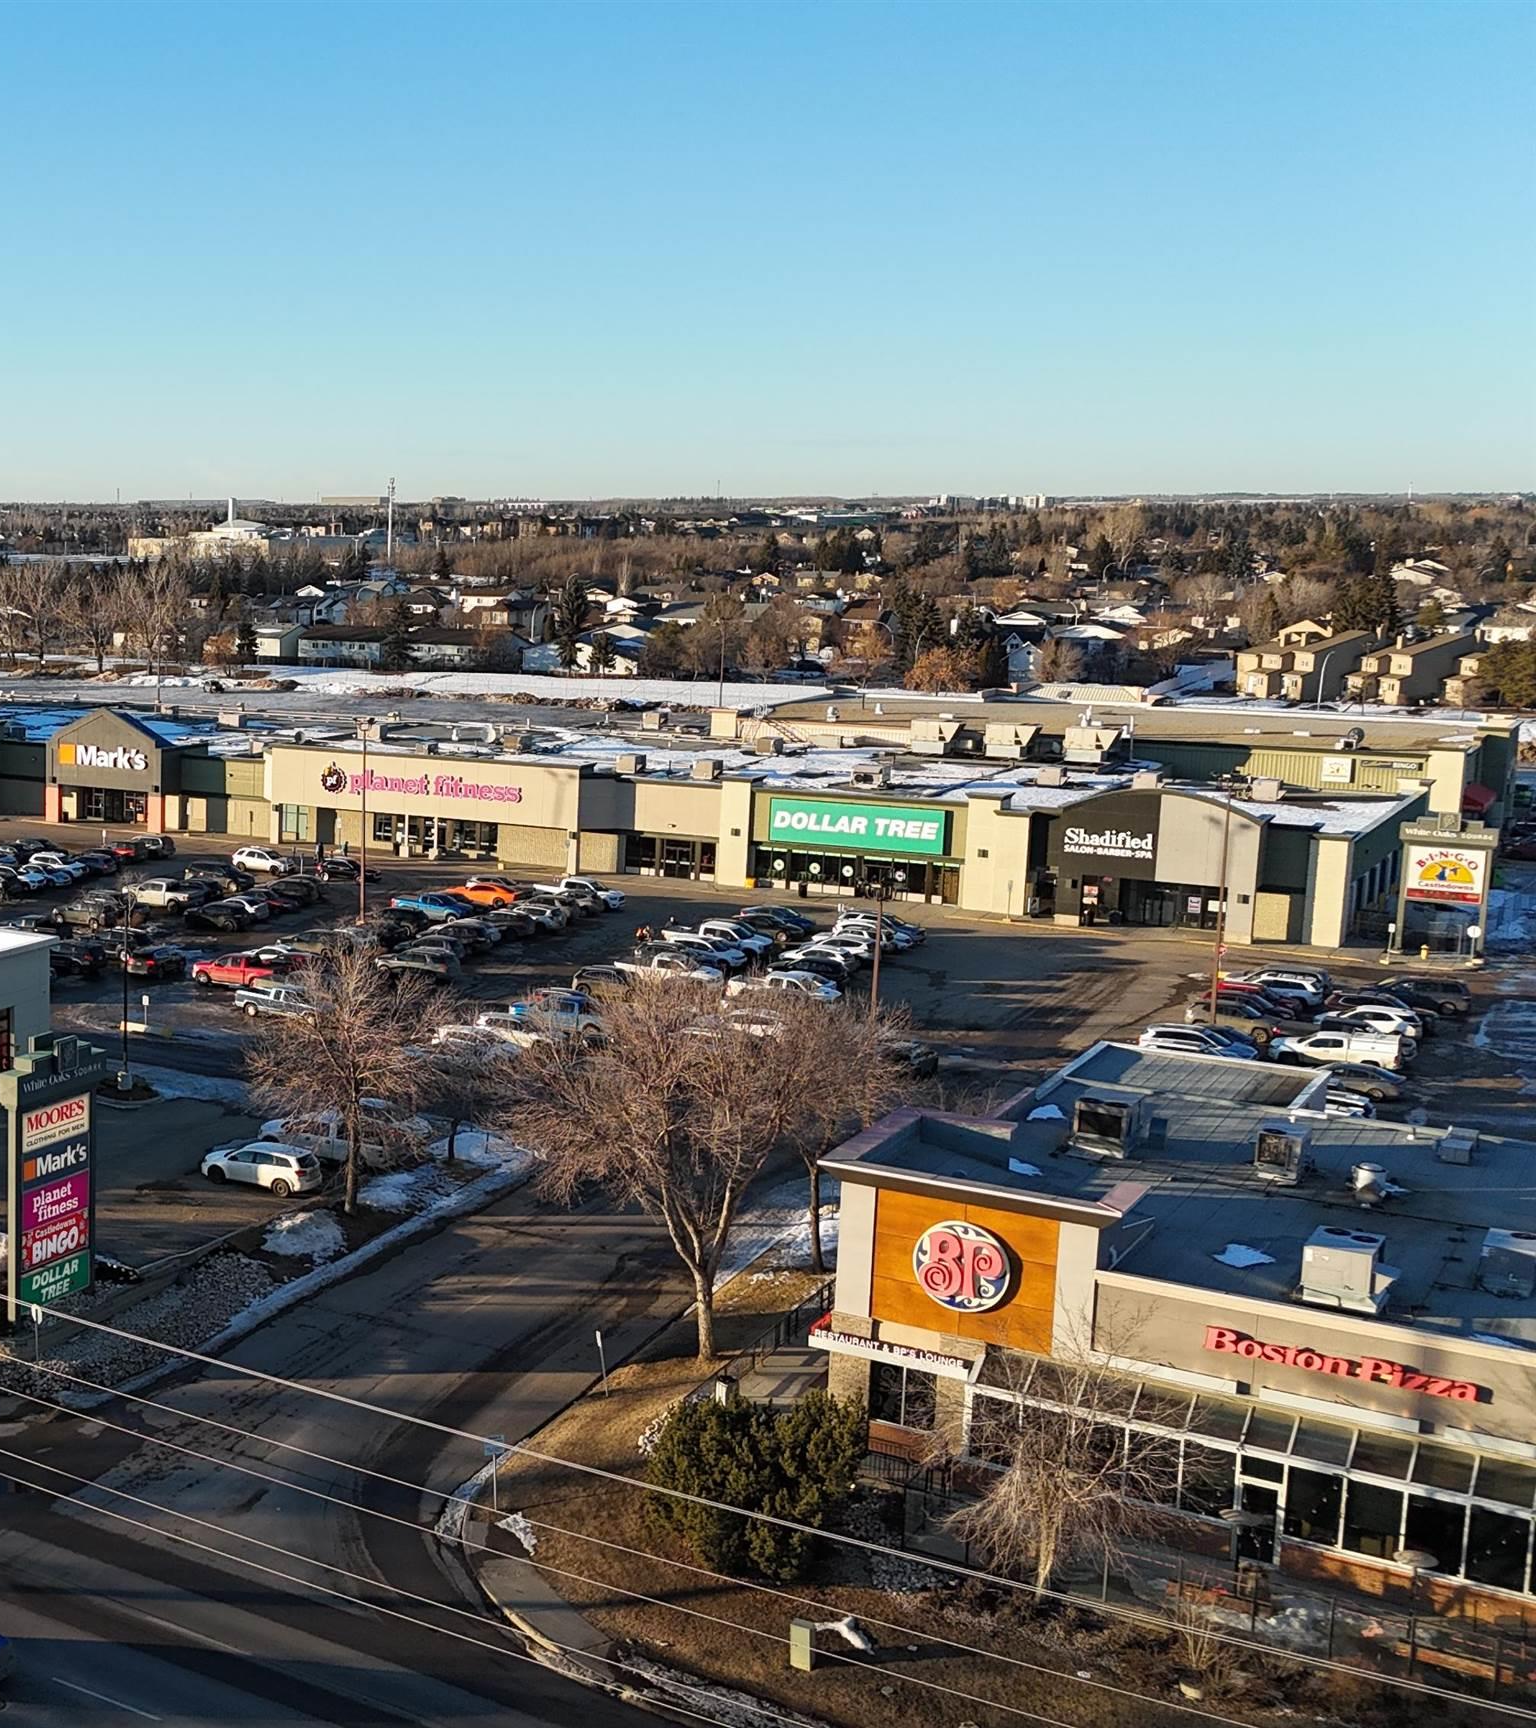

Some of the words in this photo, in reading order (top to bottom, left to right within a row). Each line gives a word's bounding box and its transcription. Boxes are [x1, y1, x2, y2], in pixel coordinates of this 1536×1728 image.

[76, 744, 147, 770] Mark's
[349, 769, 427, 795] planet
[433, 775, 521, 803] fitness
[773, 810, 868, 835] DOLLAR
[874, 817, 940, 841] TREE
[1064, 827, 1153, 850] Shadified
[1405, 827, 1432, 837] White
[23, 1078, 47, 1093] White
[48, 1071, 71, 1086] Oaks
[73, 1063, 102, 1078] SQUARE
[26, 1099, 85, 1134] MOORES
[26, 1132, 57, 1147] CLOTHING
[58, 1128, 71, 1137] FOR
[71, 1122, 85, 1132] MEN
[36, 1142, 87, 1177] Mark's
[32, 1181, 72, 1213] planet
[37, 1196, 79, 1223] fitness
[35, 1217, 77, 1239] Castledowns
[31, 1226, 79, 1265] BINGO
[31, 1258, 79, 1291] DOLLAR
[40, 1278, 71, 1303] TREE
[814, 1328, 879, 1351] RESTAURANT
[882, 1343, 890, 1352] &
[893, 1345, 917, 1359] BP'S
[919, 1351, 965, 1369] LOUNGE
[1204, 1325, 1357, 1378] Boston
[1354, 1355, 1478, 1403] Pizza
